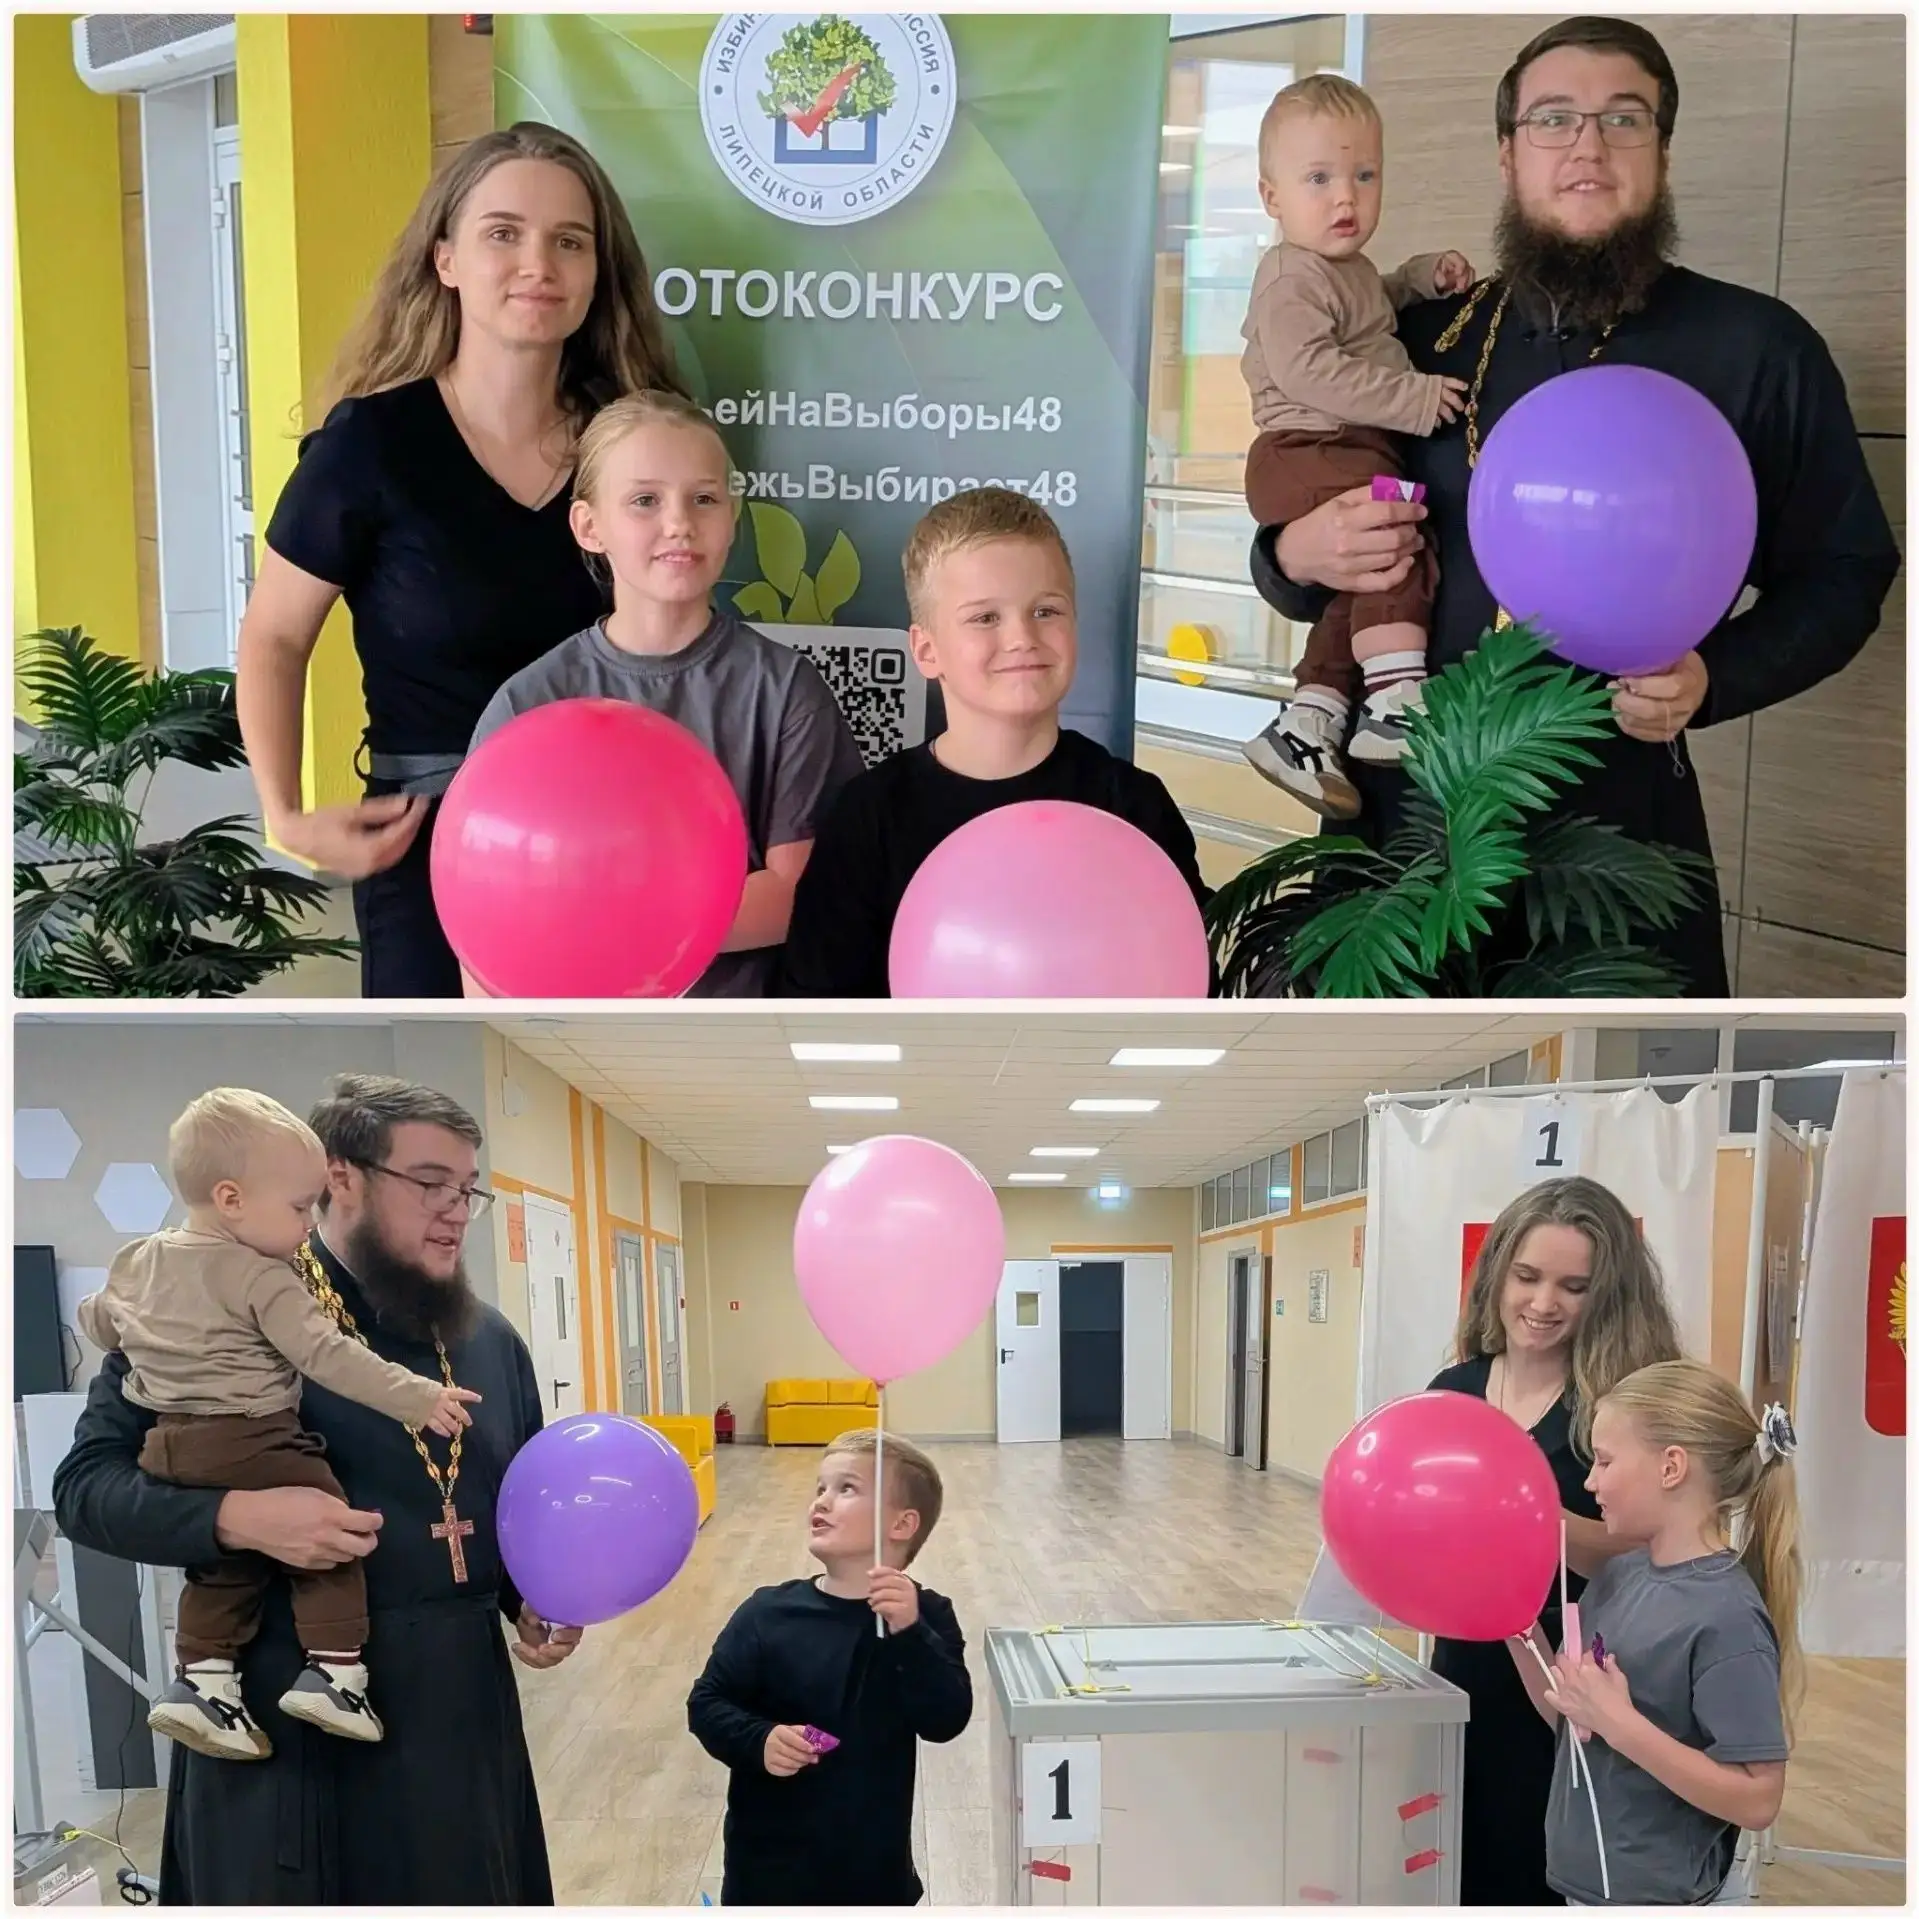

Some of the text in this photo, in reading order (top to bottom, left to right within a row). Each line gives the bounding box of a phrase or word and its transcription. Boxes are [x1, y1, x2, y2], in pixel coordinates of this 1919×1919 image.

[903, 13, 939, 73] ССИЯ
[720, 124, 934, 210] ЛИПЕЦКОЙ ОБЛАСТИ
[653, 267, 1063, 321] ОТОКОНКУРС
[702, 389, 1062, 439] ейНаВыборы48
[1535, 1121, 1563, 1166] 1
[1048, 1759, 1073, 1819] 1
